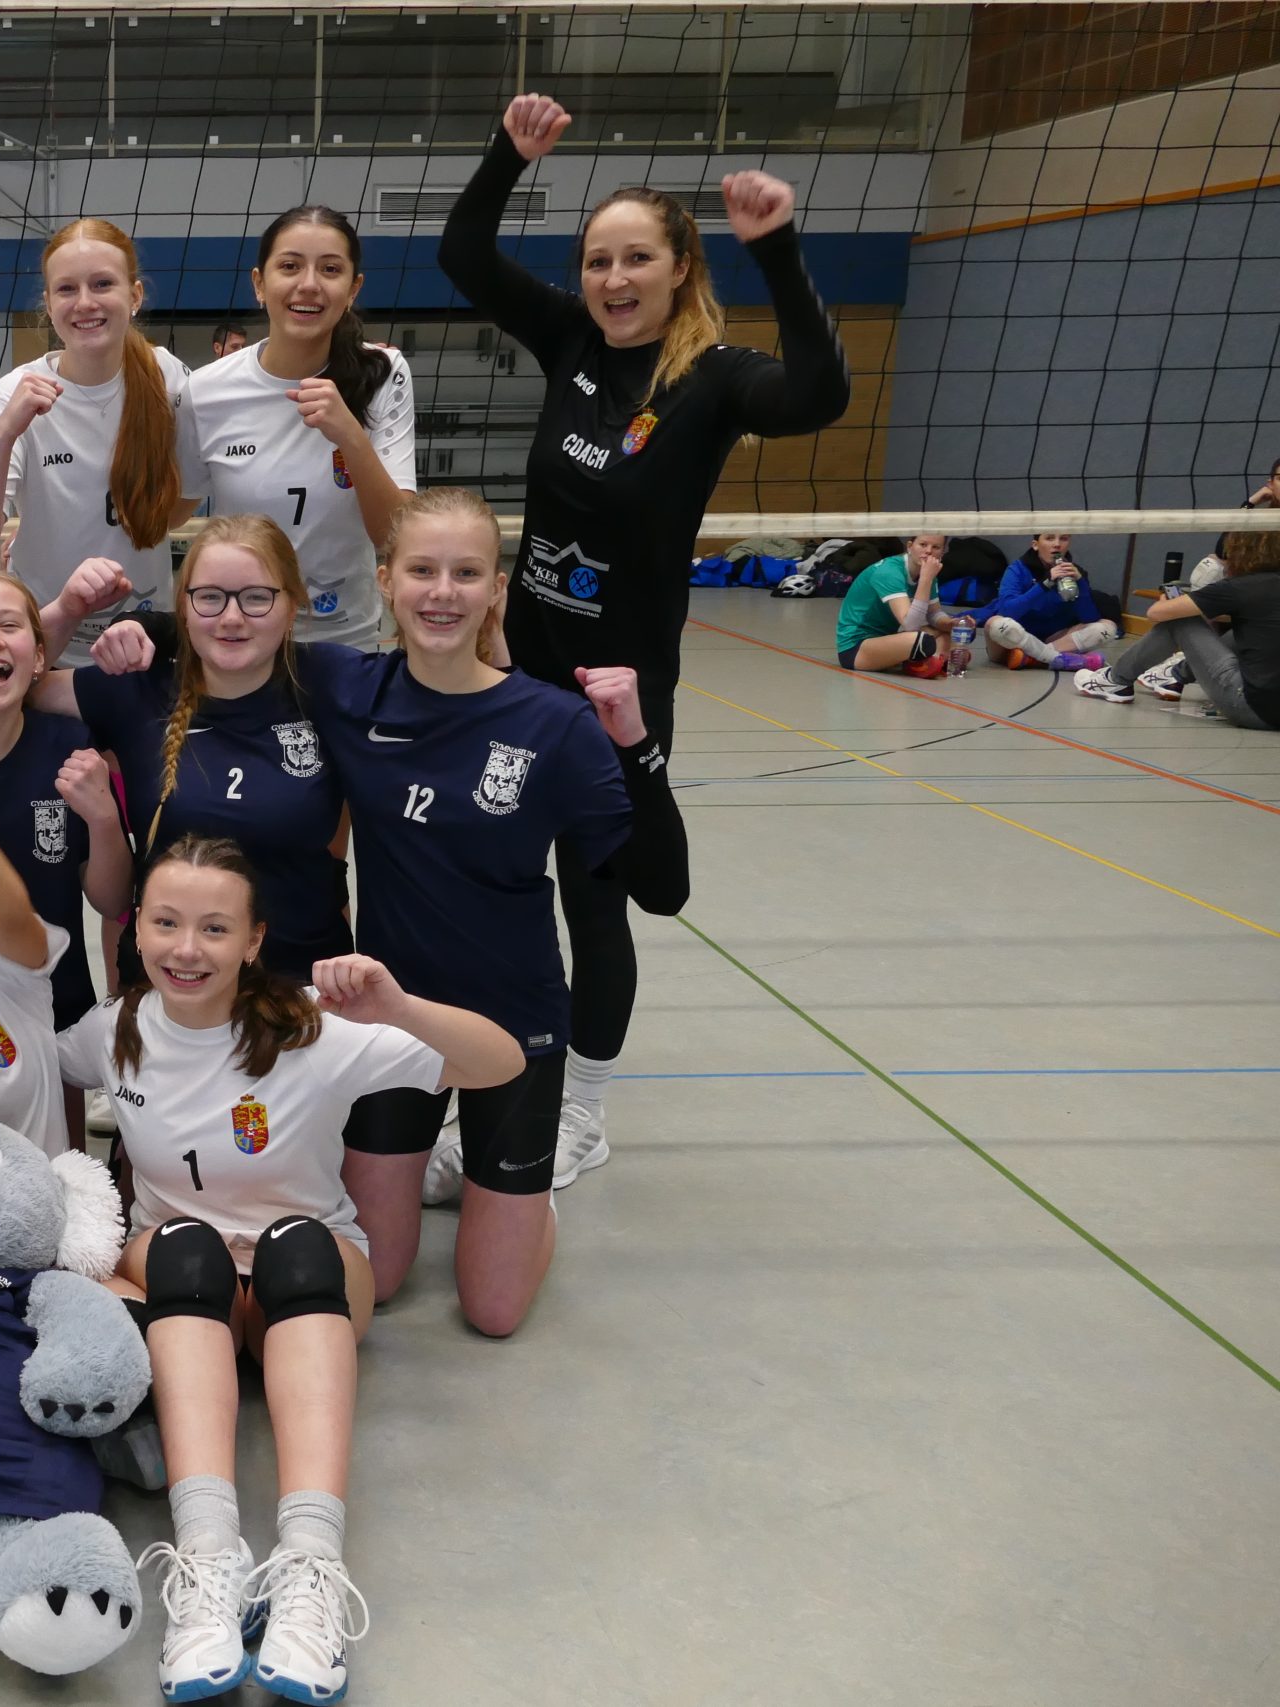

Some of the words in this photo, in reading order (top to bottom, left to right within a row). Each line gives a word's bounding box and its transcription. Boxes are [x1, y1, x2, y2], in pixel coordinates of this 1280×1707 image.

[573, 371, 597, 396] JAKO
[43, 452, 74, 467] JAKO
[225, 445, 256, 457] JAKO
[562, 433, 610, 470] COACH
[287, 487, 307, 526] 7
[489, 740, 537, 760] GYMNASIUM
[226, 767, 244, 800] 2
[403, 783, 435, 824] 12
[472, 790, 520, 816] GEORGIANUM
[114, 1085, 146, 1108] JAKO
[182, 1149, 204, 1192] 1
